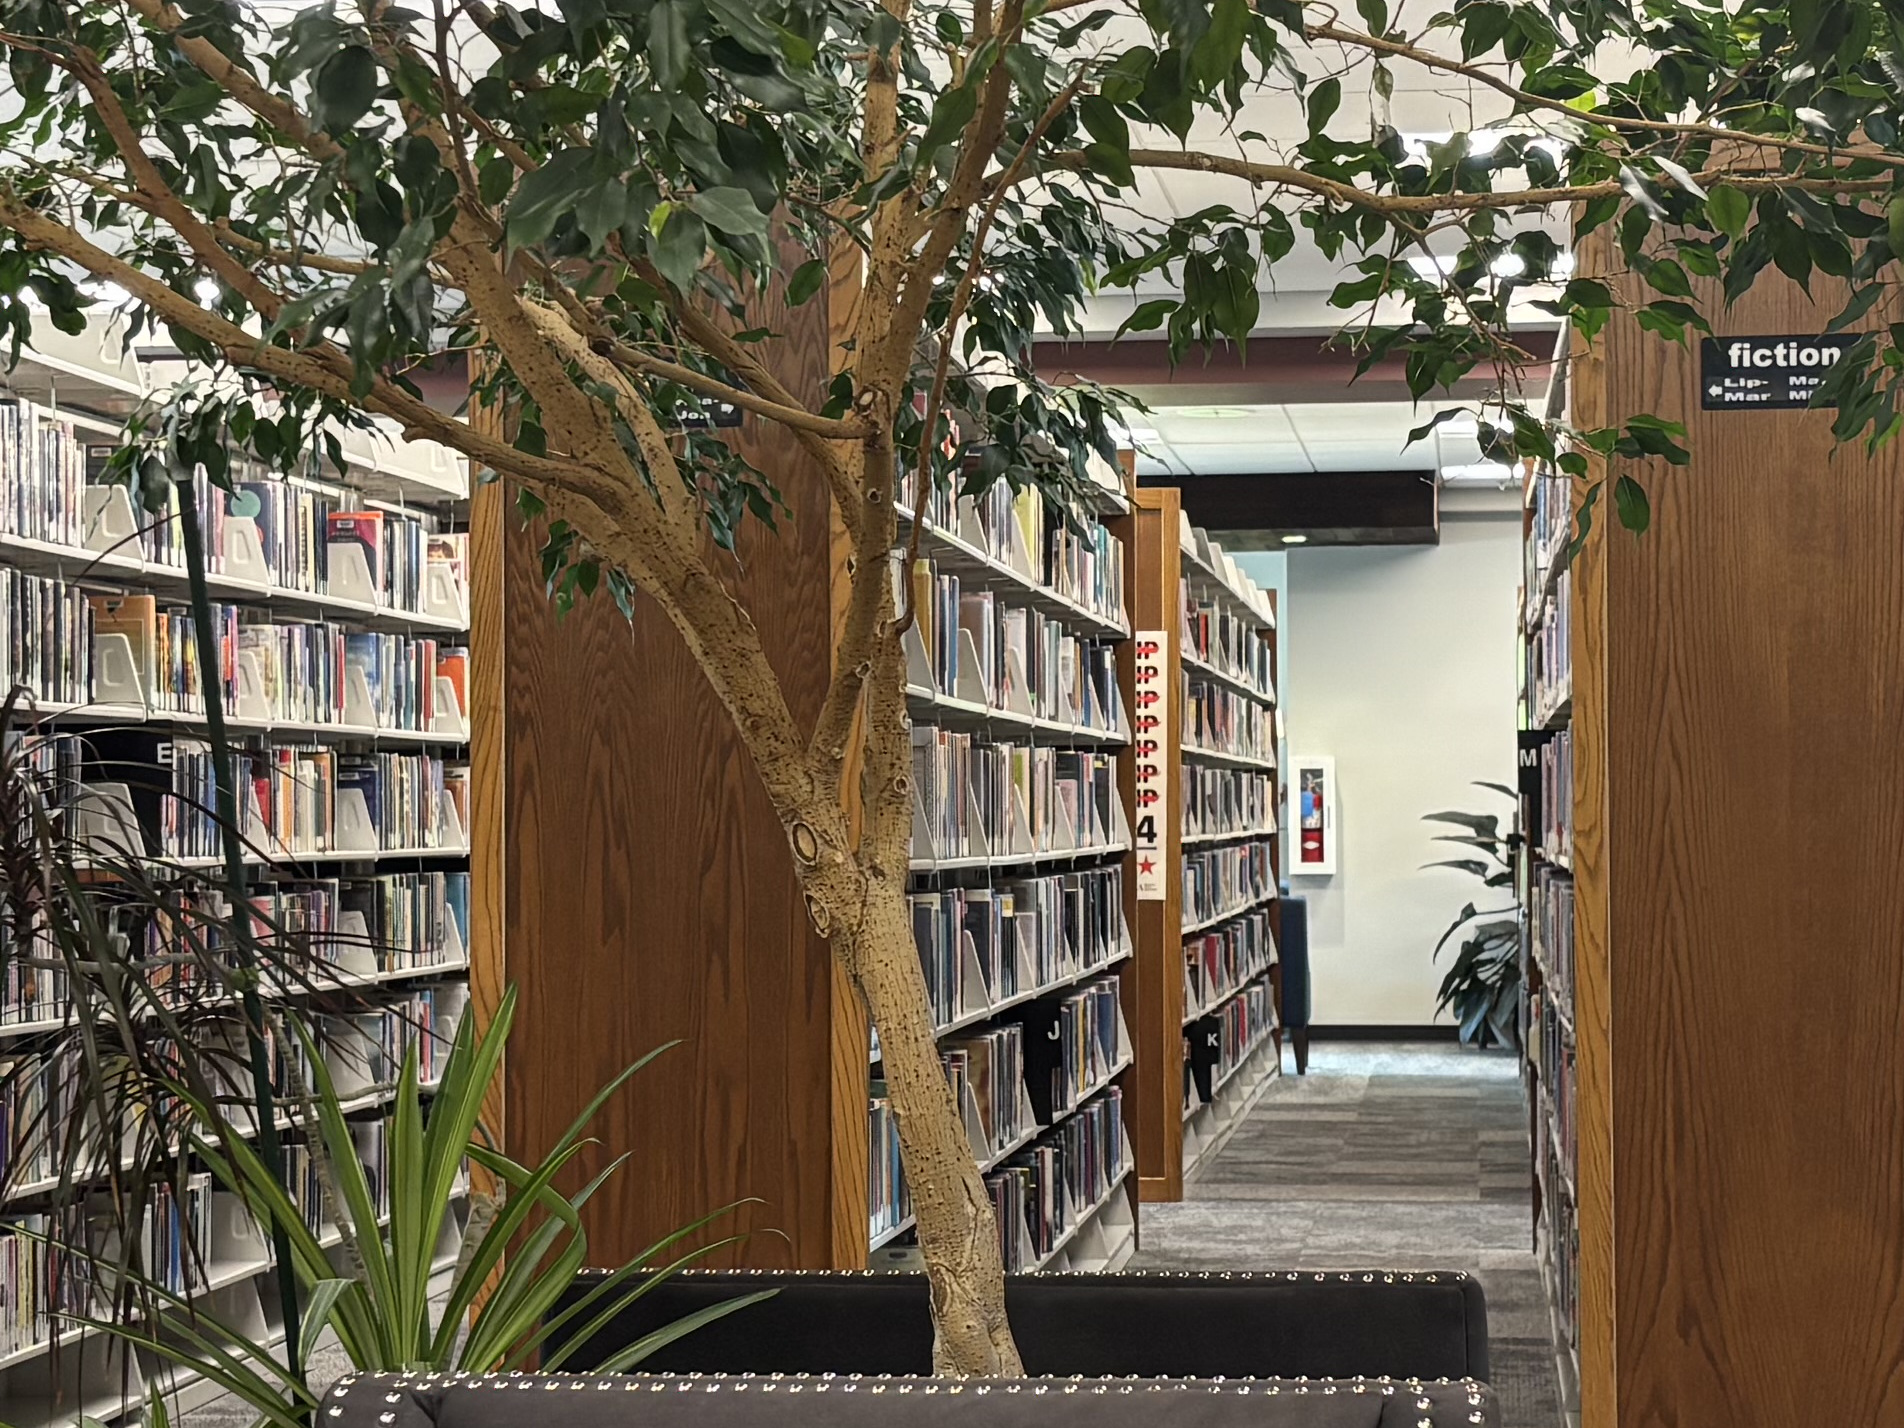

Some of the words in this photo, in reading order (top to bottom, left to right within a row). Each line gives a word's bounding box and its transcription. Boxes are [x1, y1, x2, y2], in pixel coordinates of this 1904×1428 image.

[1727, 342, 1842, 368] fiction
[1724, 392, 1771, 402] Mar
[157, 743, 173, 764] E
[1519, 748, 1537, 767] M
[1136, 815, 1158, 844] 4
[1047, 1020, 1060, 1040] J
[1207, 1033, 1219, 1047] K
